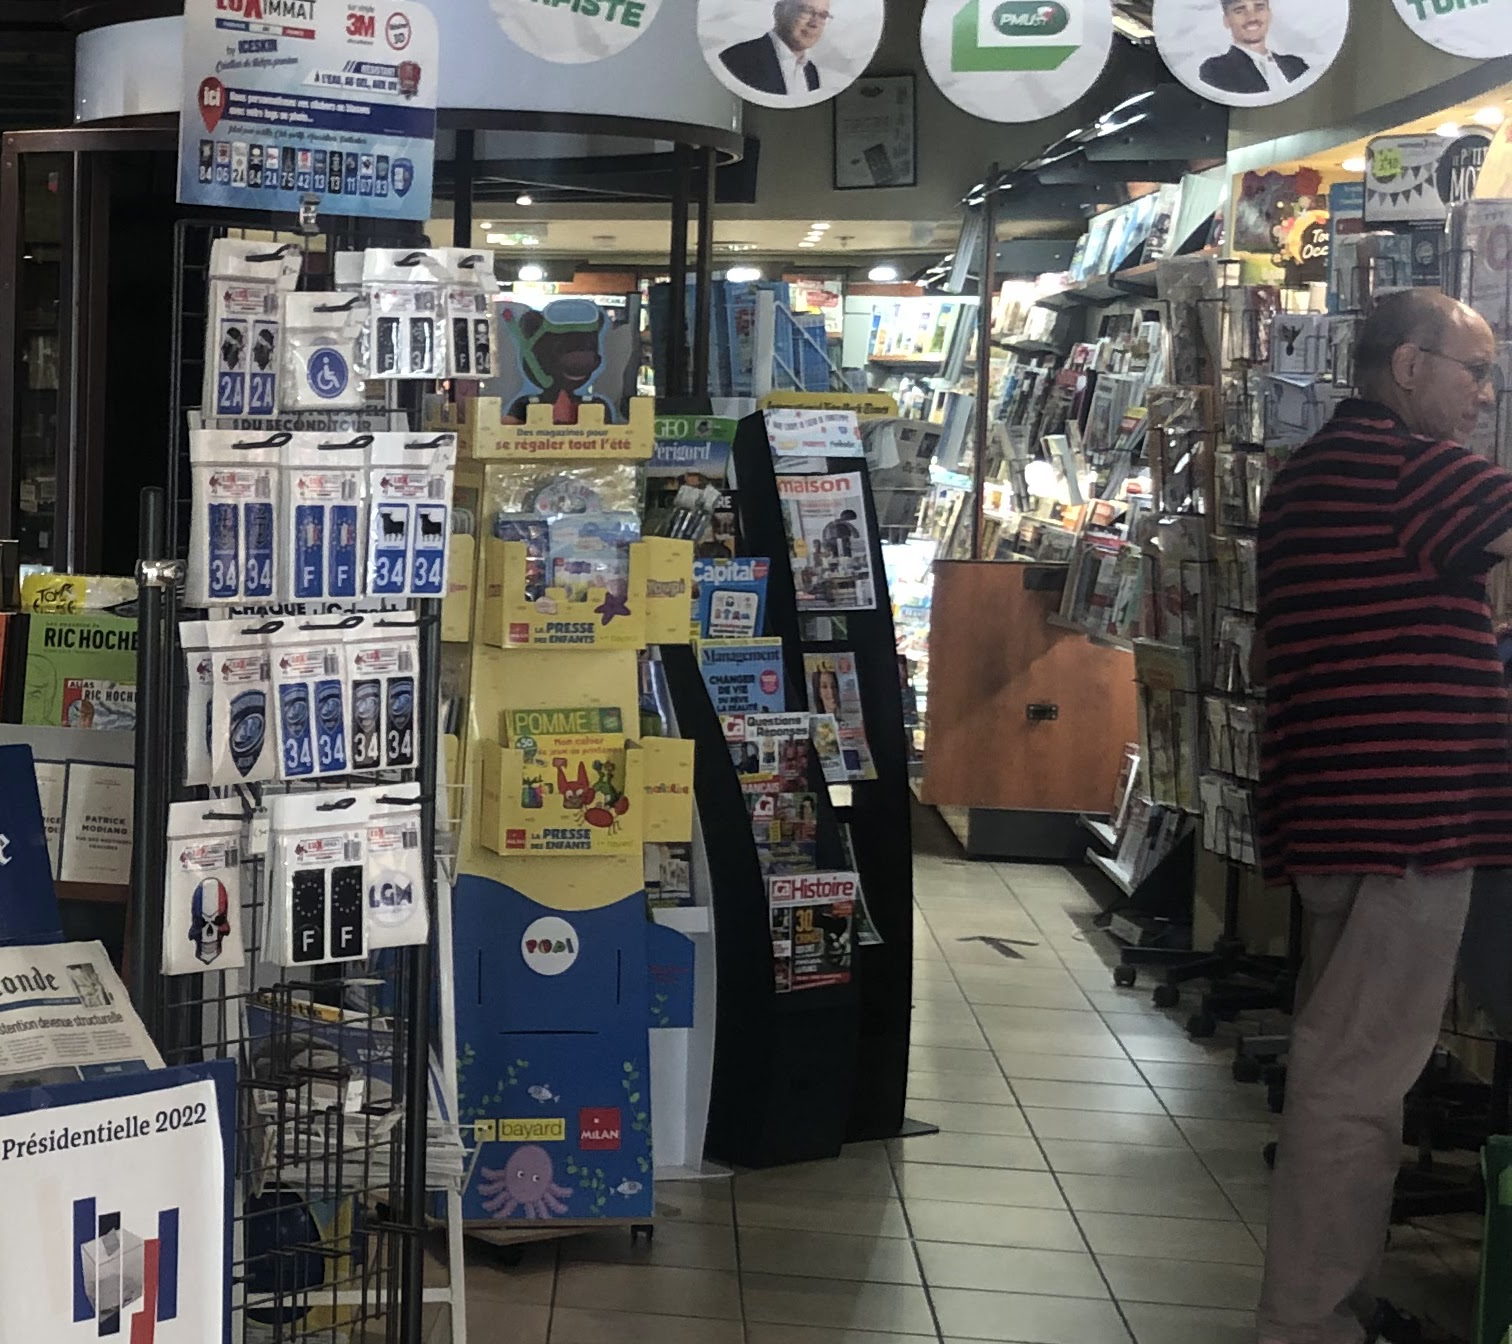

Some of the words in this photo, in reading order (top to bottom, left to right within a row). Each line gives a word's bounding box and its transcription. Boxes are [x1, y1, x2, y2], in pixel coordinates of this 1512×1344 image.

[346, 13, 375, 38] 3M
[999, 13, 1040, 26] PMU
[204, 87, 220, 106] ici
[298, 174, 310, 188] 42
[220, 375, 242, 407] 2A
[251, 375, 273, 407] 2A
[268, 419, 325, 431] SECOND
[328, 420, 371, 432] TOUR
[517, 429, 533, 437] Des
[536, 429, 584, 438] magazines
[587, 430, 608, 438] pour
[654, 419, 688, 437] GEO
[496, 441, 510, 449] se
[515, 439, 563, 453] régaler
[568, 440, 596, 450] tout
[600, 439, 631, 450] l'été
[778, 477, 850, 494] maison
[212, 559, 236, 590] 34
[246, 559, 271, 590] 34
[303, 567, 315, 588] F
[338, 566, 349, 587] F
[376, 557, 404, 586] 34
[414, 557, 441, 586] 34
[693, 560, 755, 585] Capital
[546, 622, 594, 634] PRESSE
[44, 627, 76, 648] RIC
[79, 629, 138, 651] HOCHE
[549, 635, 595, 644] ENFANTS
[703, 649, 780, 665] Management
[709, 675, 755, 685] CHANGER
[718, 686, 730, 695] DE
[731, 686, 748, 695] VIE
[514, 710, 587, 733] POMME
[747, 716, 801, 727] Questions
[757, 727, 808, 738] Réponses
[285, 738, 312, 769] 34
[319, 733, 345, 764] 34
[353, 731, 379, 763] 34
[386, 728, 412, 760] 34
[82, 824, 127, 835] MODIANO
[85, 815, 125, 825] PATRICK
[543, 829, 591, 840] PRESSE
[545, 841, 591, 850] ENFANTS
[369, 882, 413, 908] LGM
[792, 877, 854, 900] Histoire
[795, 910, 813, 932] 30
[302, 930, 315, 951] F
[341, 927, 353, 948] F
[38, 1016, 73, 1030] devenue
[73, 1012, 124, 1028] structurelle
[1, 1115, 150, 1160] Présidentielle
[156, 1103, 207, 1134] 2022
[502, 1120, 562, 1138] bayard
